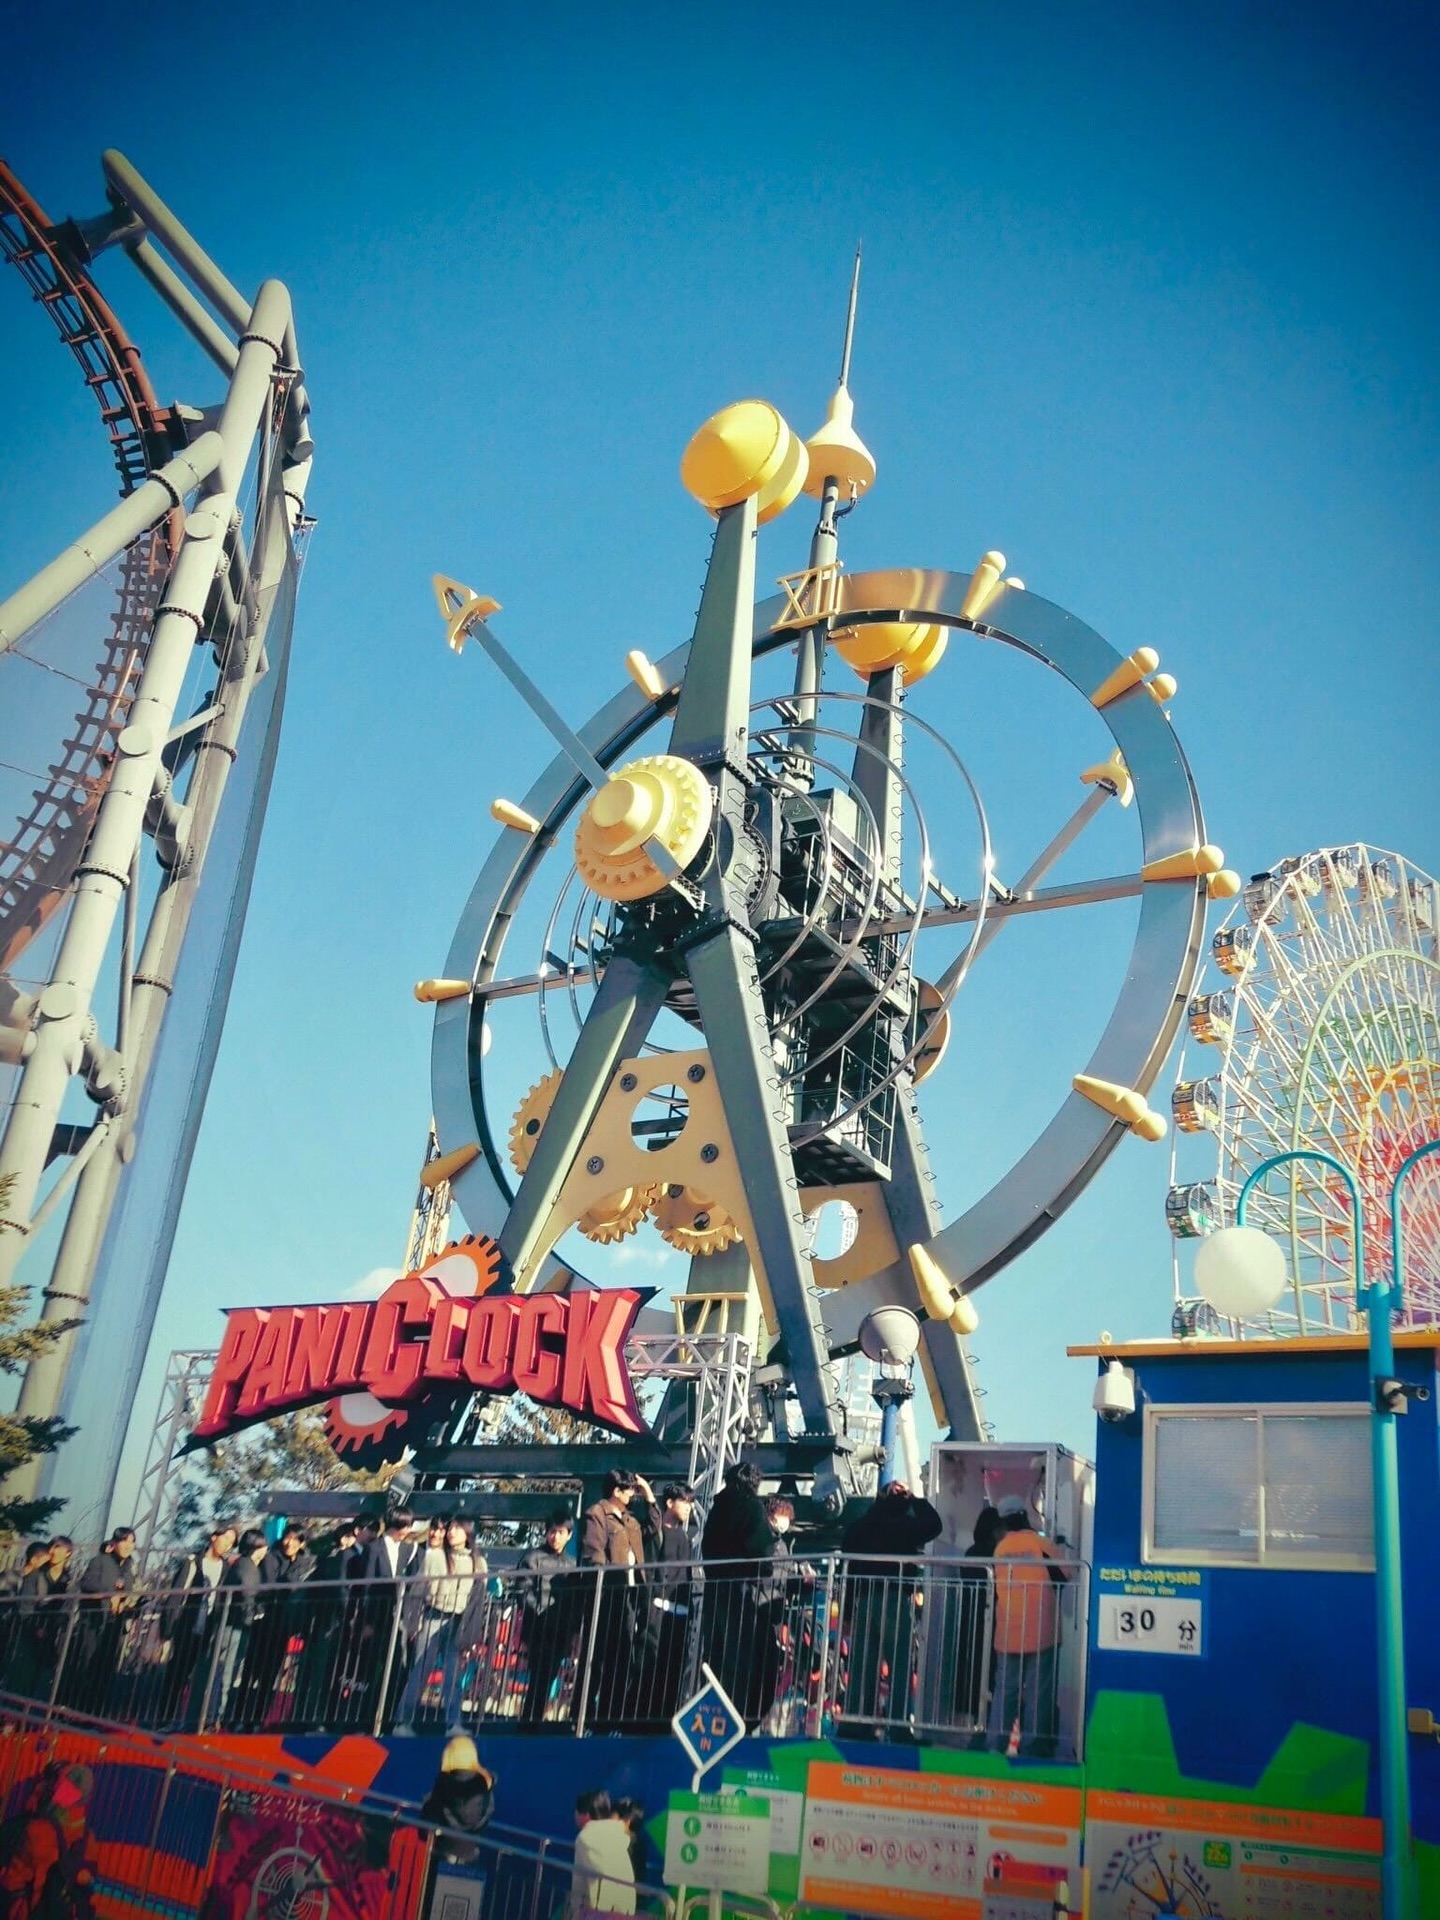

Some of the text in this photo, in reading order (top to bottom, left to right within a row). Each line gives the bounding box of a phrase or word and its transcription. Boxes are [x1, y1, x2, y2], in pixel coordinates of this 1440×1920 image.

[1120, 1608, 1196, 1641] 30 分
[691, 1712, 726, 1736] 入口
[700, 1737, 711, 1751] IN
